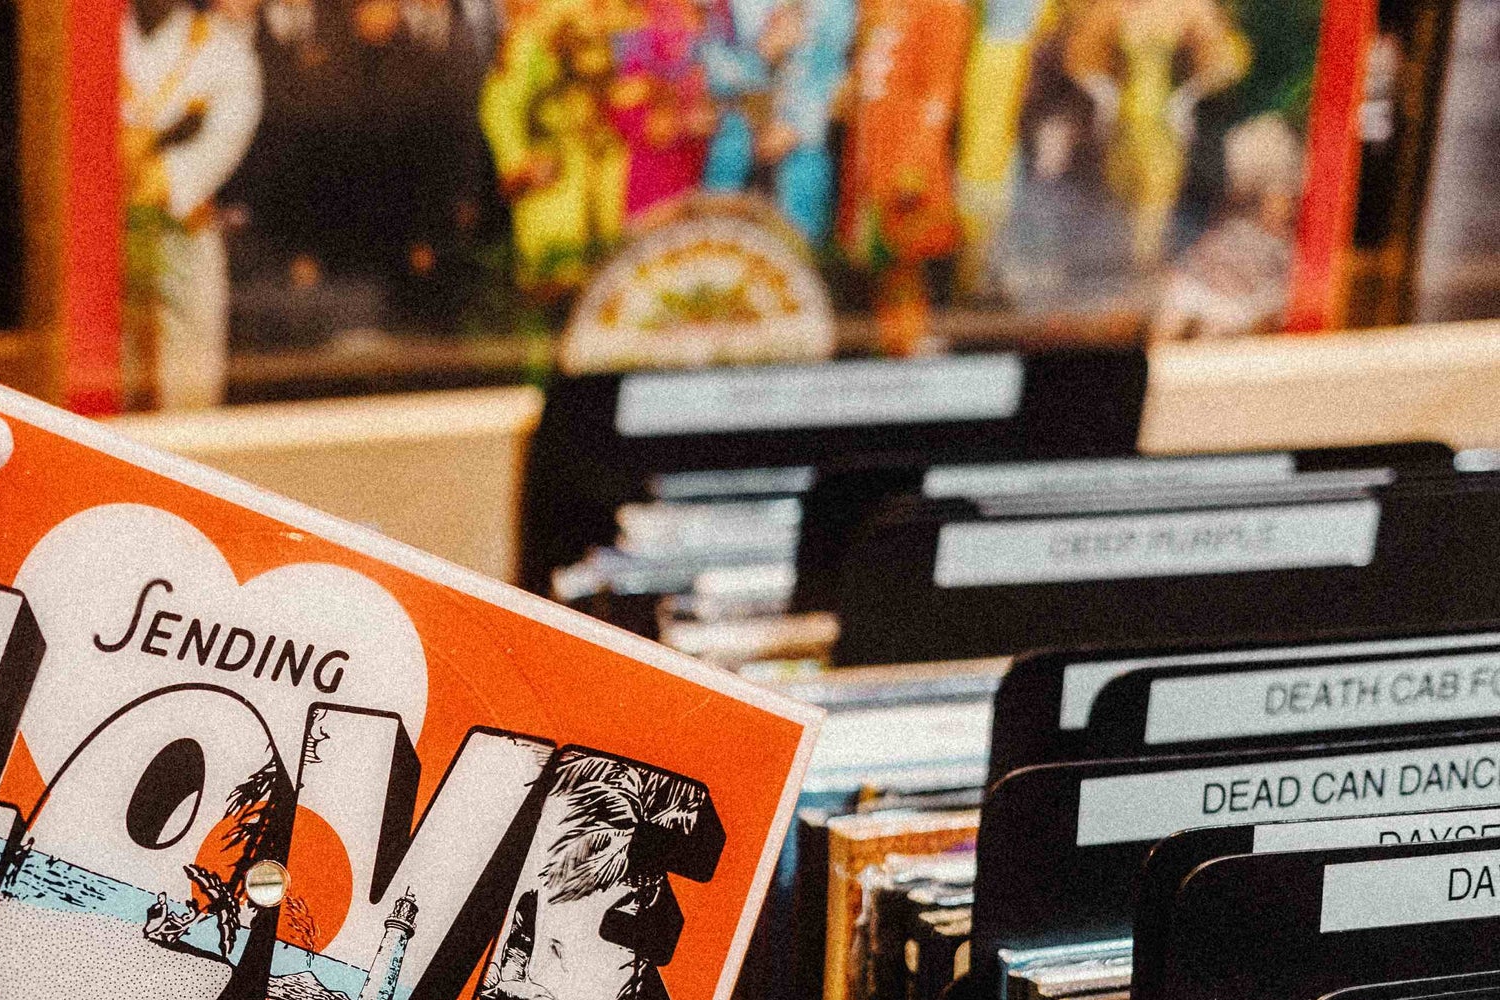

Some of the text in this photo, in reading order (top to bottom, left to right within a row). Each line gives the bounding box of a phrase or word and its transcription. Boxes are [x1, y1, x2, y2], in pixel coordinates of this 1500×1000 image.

[93, 578, 350, 695] SENDING
[1264, 676, 1381, 717] DEATH
[1390, 670, 1460, 703] CAB
[1202, 757, 1500, 815] DEAD CAN DANC
[1447, 864, 1500, 901] DA
